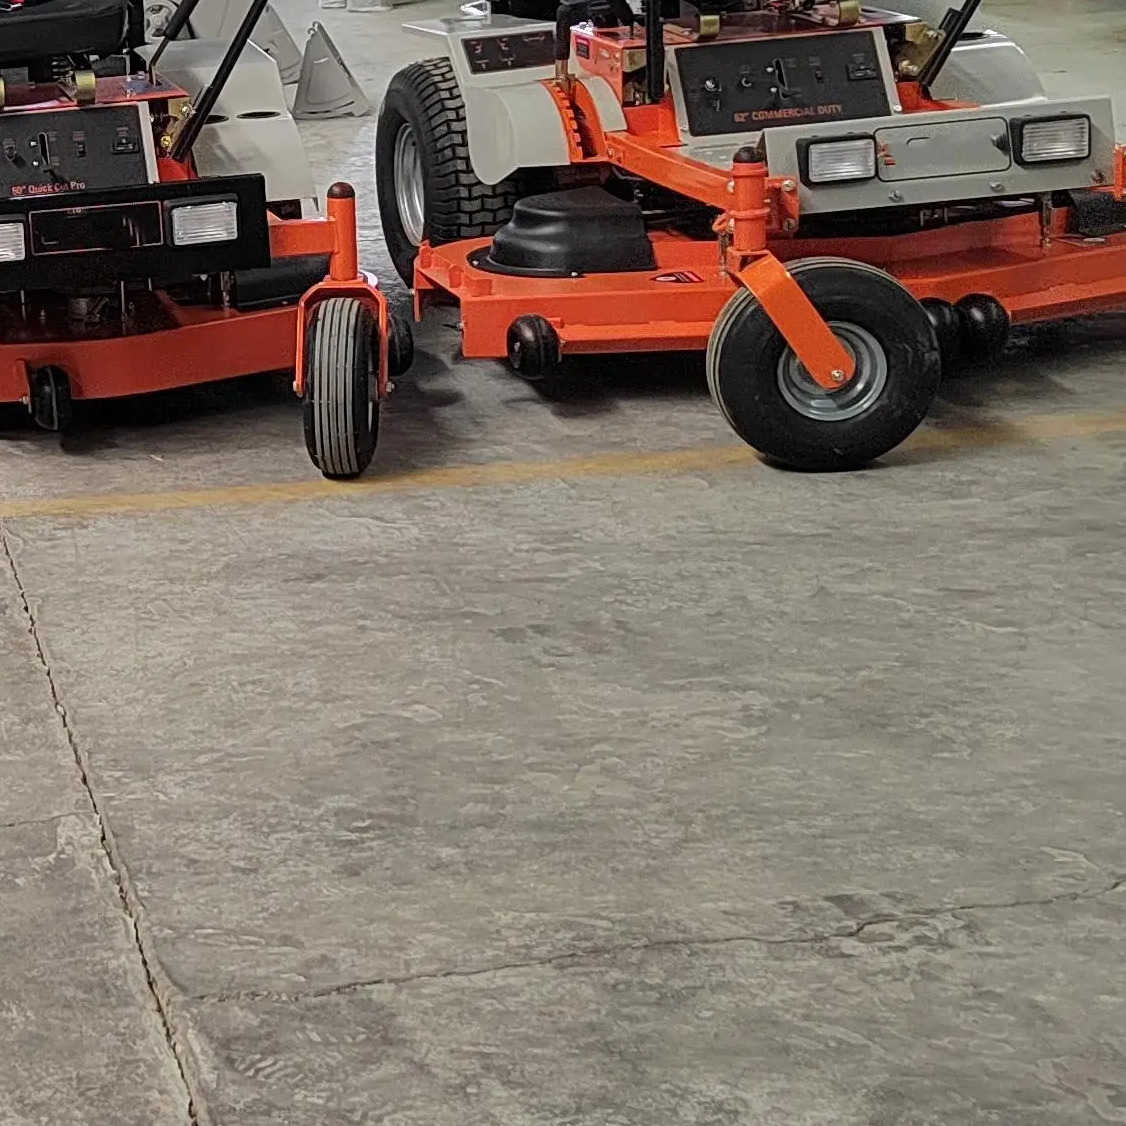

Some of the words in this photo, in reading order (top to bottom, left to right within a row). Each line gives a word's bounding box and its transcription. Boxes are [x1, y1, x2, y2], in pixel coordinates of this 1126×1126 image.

[752, 106, 815, 120] COMMERCIAL
[817, 103, 843, 114] DUTY
[28, 182, 53, 193] Quick
[70, 180, 86, 190] Pro
